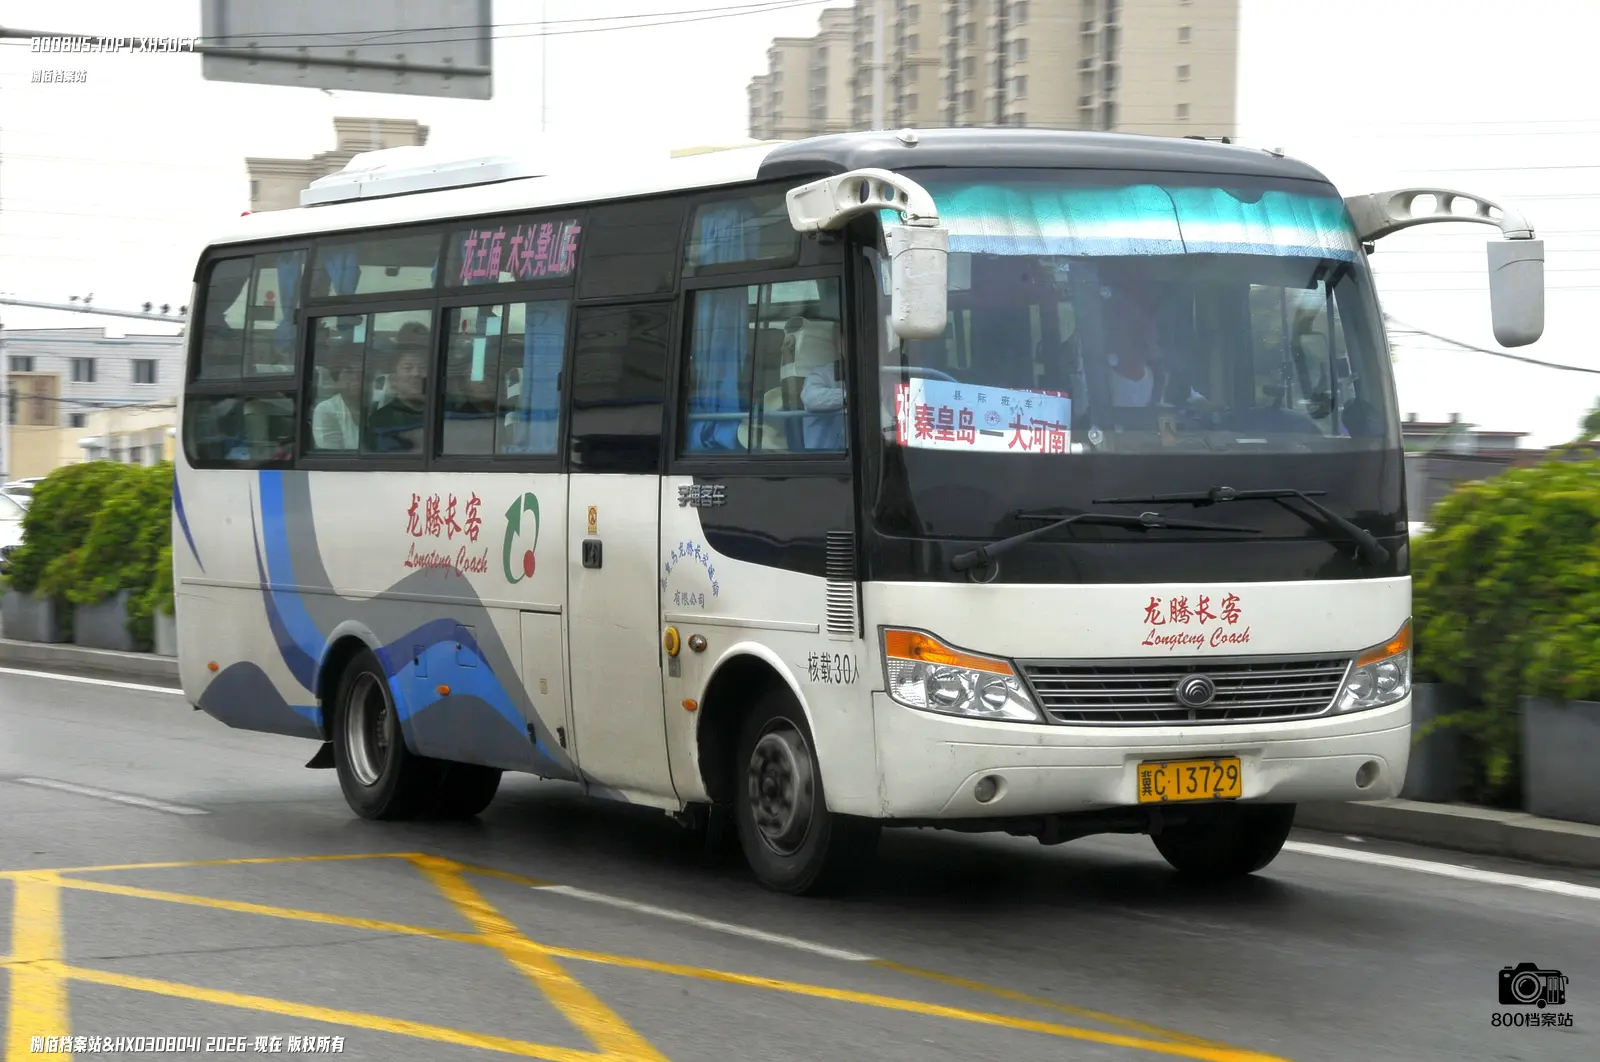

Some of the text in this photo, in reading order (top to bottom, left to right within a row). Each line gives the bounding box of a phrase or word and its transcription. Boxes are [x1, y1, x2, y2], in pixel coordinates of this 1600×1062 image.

[460, 226, 506, 280] 龙王庙
[406, 491, 482, 543] 龙腾长客
[404, 541, 488, 579] Longteng Coach
[673, 590, 705, 609] 有限公司
[1144, 592, 1242, 625] 龙腾长客
[1141, 625, 1251, 651] Longteng Coach
[808, 651, 860, 684] 核载30人
